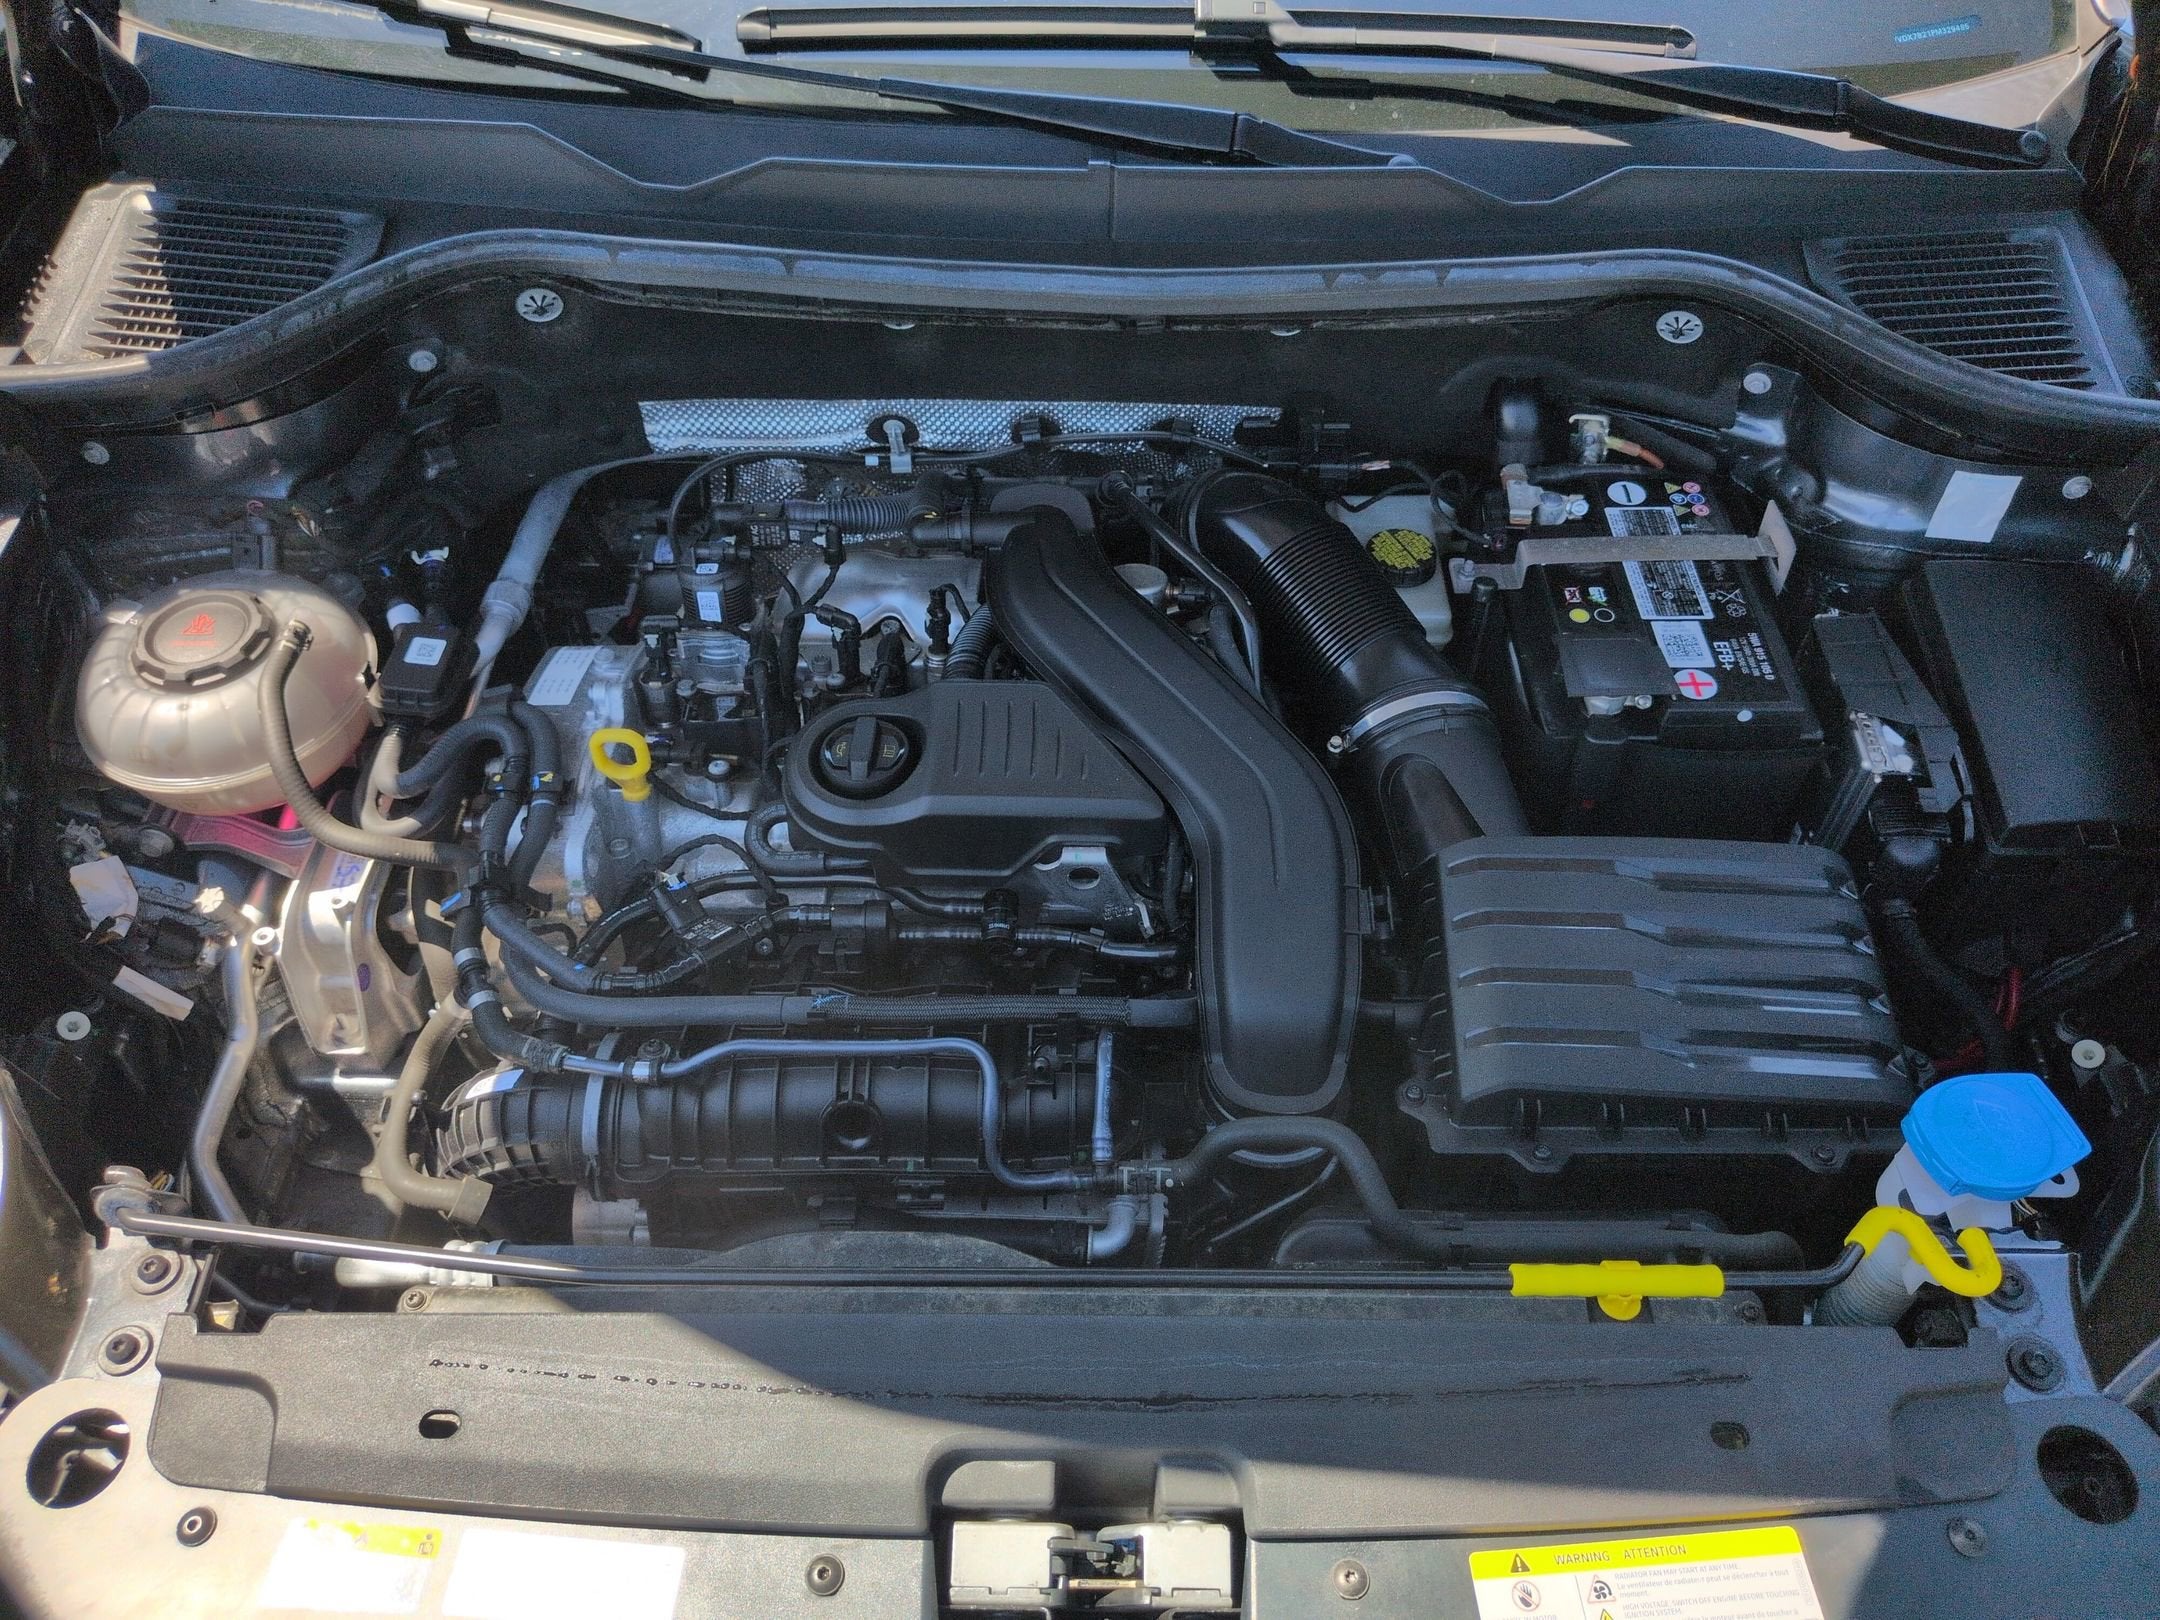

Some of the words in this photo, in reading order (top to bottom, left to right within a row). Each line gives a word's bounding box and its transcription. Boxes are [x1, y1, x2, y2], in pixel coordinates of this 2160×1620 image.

[1713, 642, 1735, 670] EFB+
[1554, 1550, 1610, 1566] WARNING
[1624, 1544, 1687, 1560] ATTENTION
[1615, 1571, 1648, 1580] RADIATOR
[1649, 1569, 1662, 1577] FAN
[1663, 1568, 1677, 1576] MAY
[1678, 1566, 1698, 1574] START
[1699, 1565, 1707, 1573] AT
[1709, 1564, 1722, 1572] ANY
[1706, 1575, 1721, 1583] peut
[1775, 1569, 1789, 1577] tout
[1699, 1597, 1711, 1605] OFF
[1739, 1593, 1764, 1601] BEFORE
[1766, 1589, 1800, 1598] TOUCHING
[1624, 1610, 1655, 1619] IGNITION
